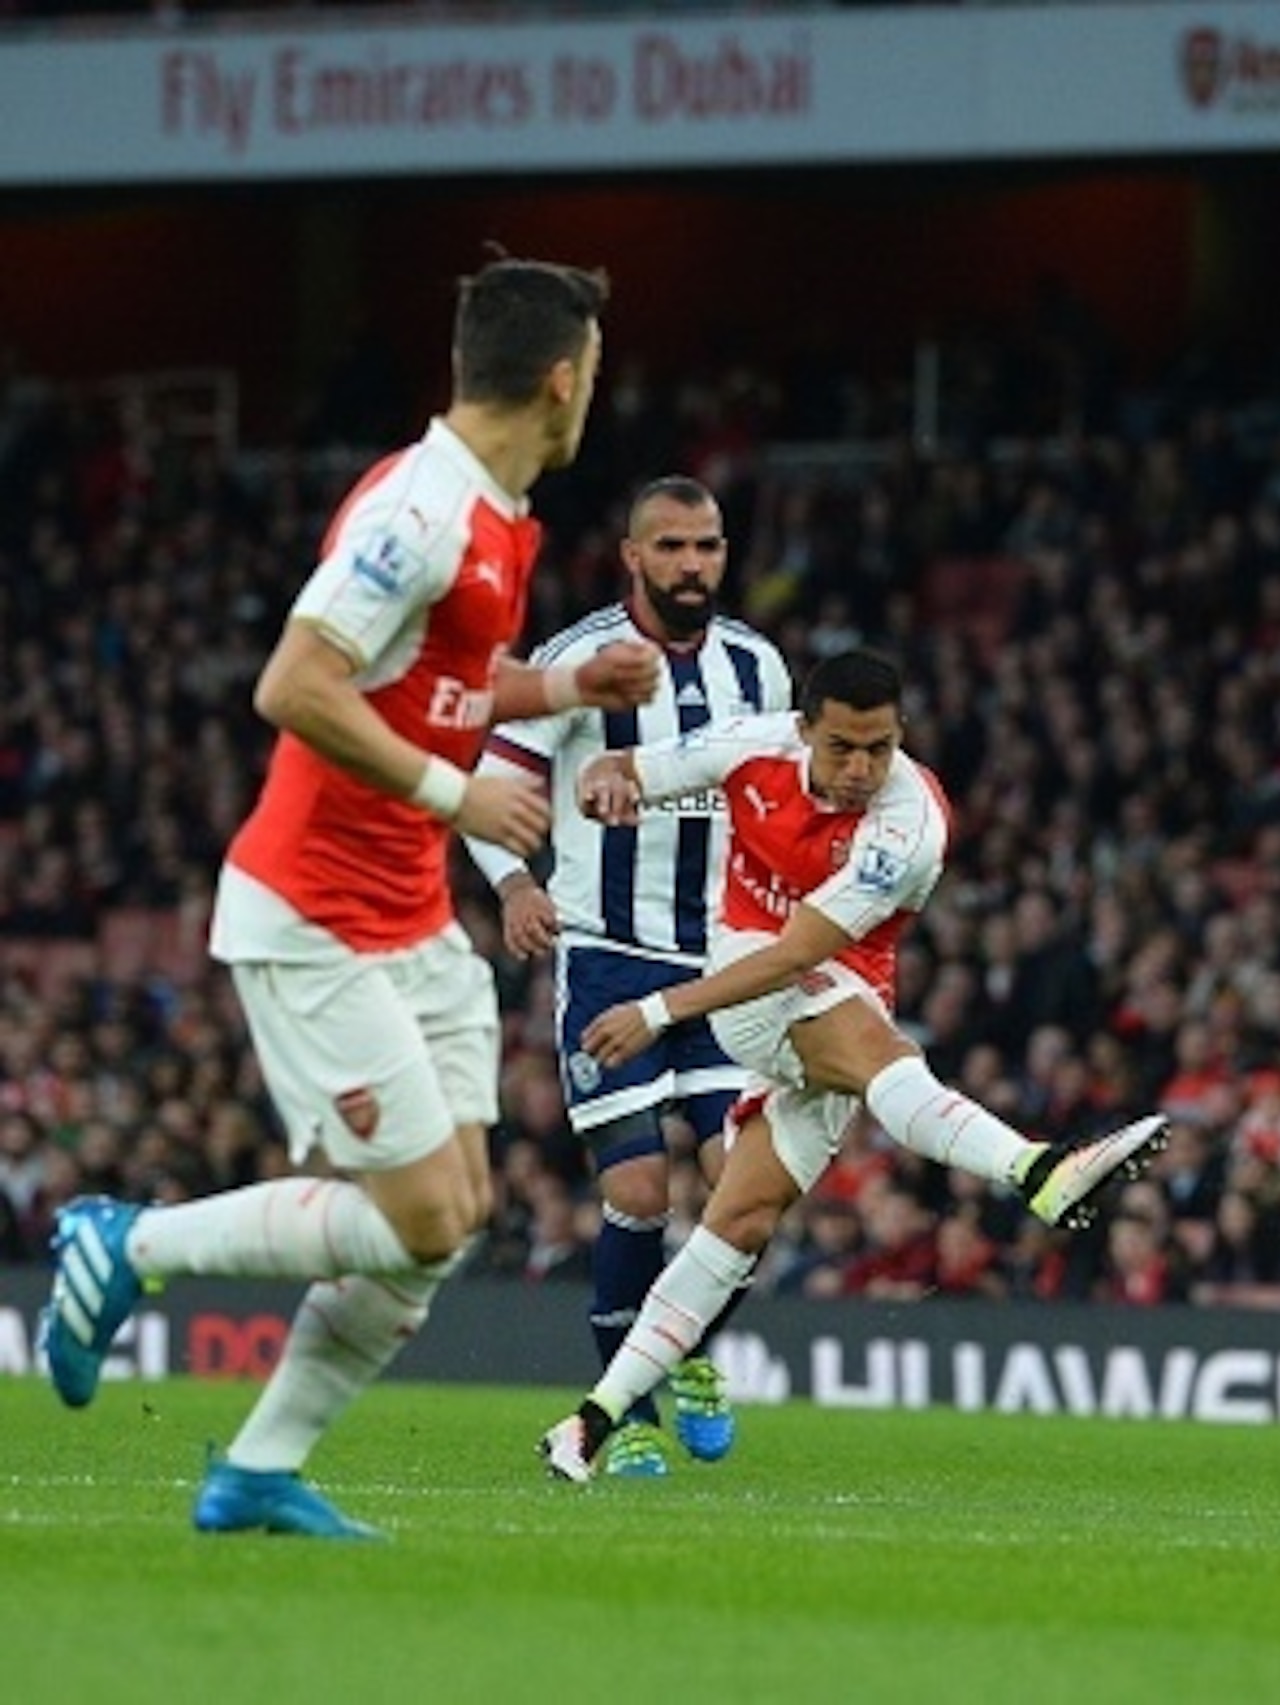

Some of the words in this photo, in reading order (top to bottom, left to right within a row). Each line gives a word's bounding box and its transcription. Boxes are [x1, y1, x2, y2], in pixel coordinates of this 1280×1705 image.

[158, 50, 256, 152] Fly
[272, 48, 534, 135] Emirates
[550, 54, 615, 124] to
[633, 32, 813, 121] Dubai
